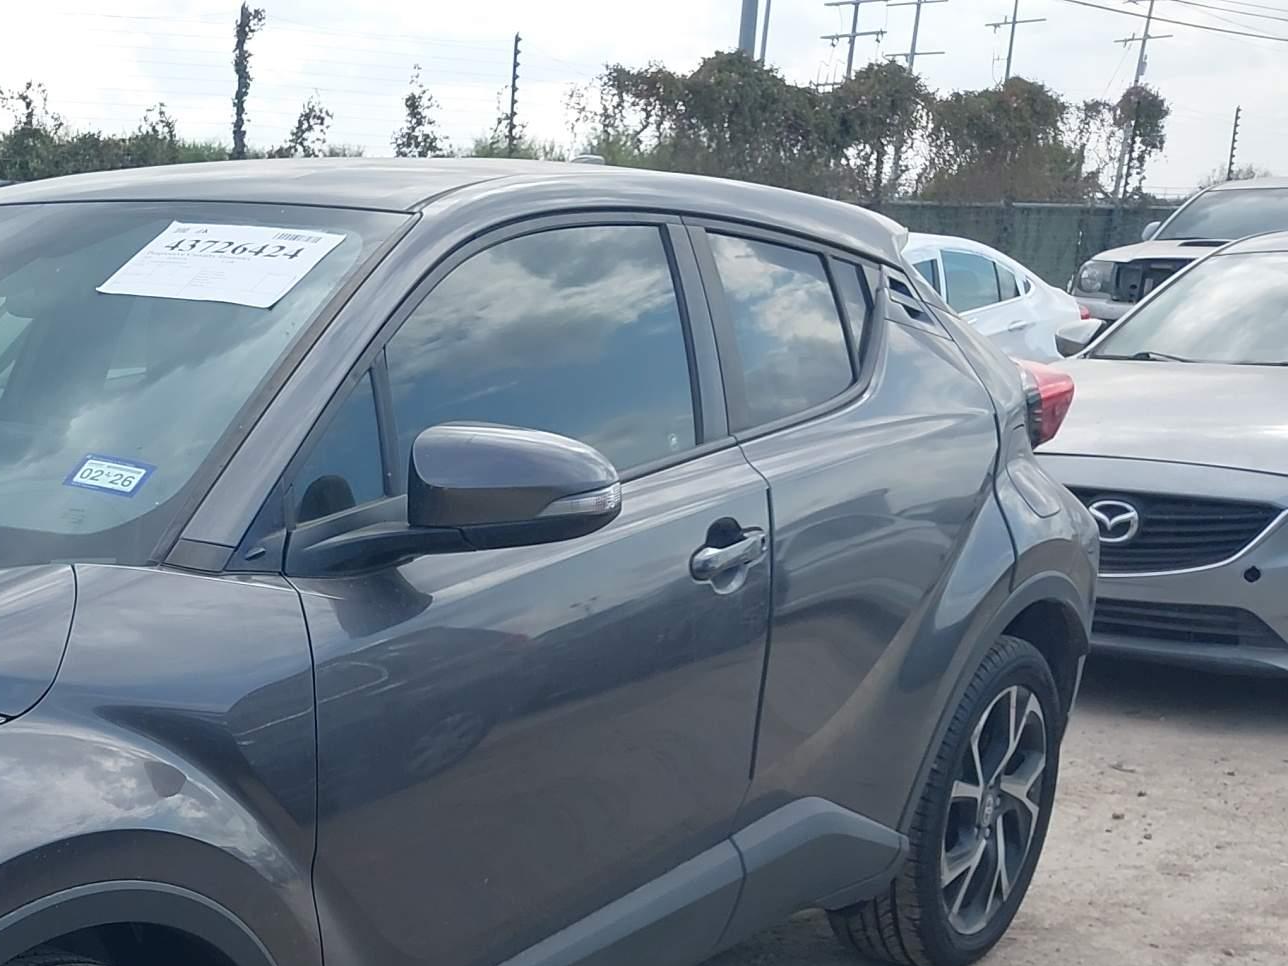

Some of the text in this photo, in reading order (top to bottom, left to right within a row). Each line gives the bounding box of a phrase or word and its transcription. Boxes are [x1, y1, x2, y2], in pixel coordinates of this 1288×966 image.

[164, 238, 306, 260] 43726424
[79, 467, 105, 482] 02
[109, 473, 136, 488] 26
